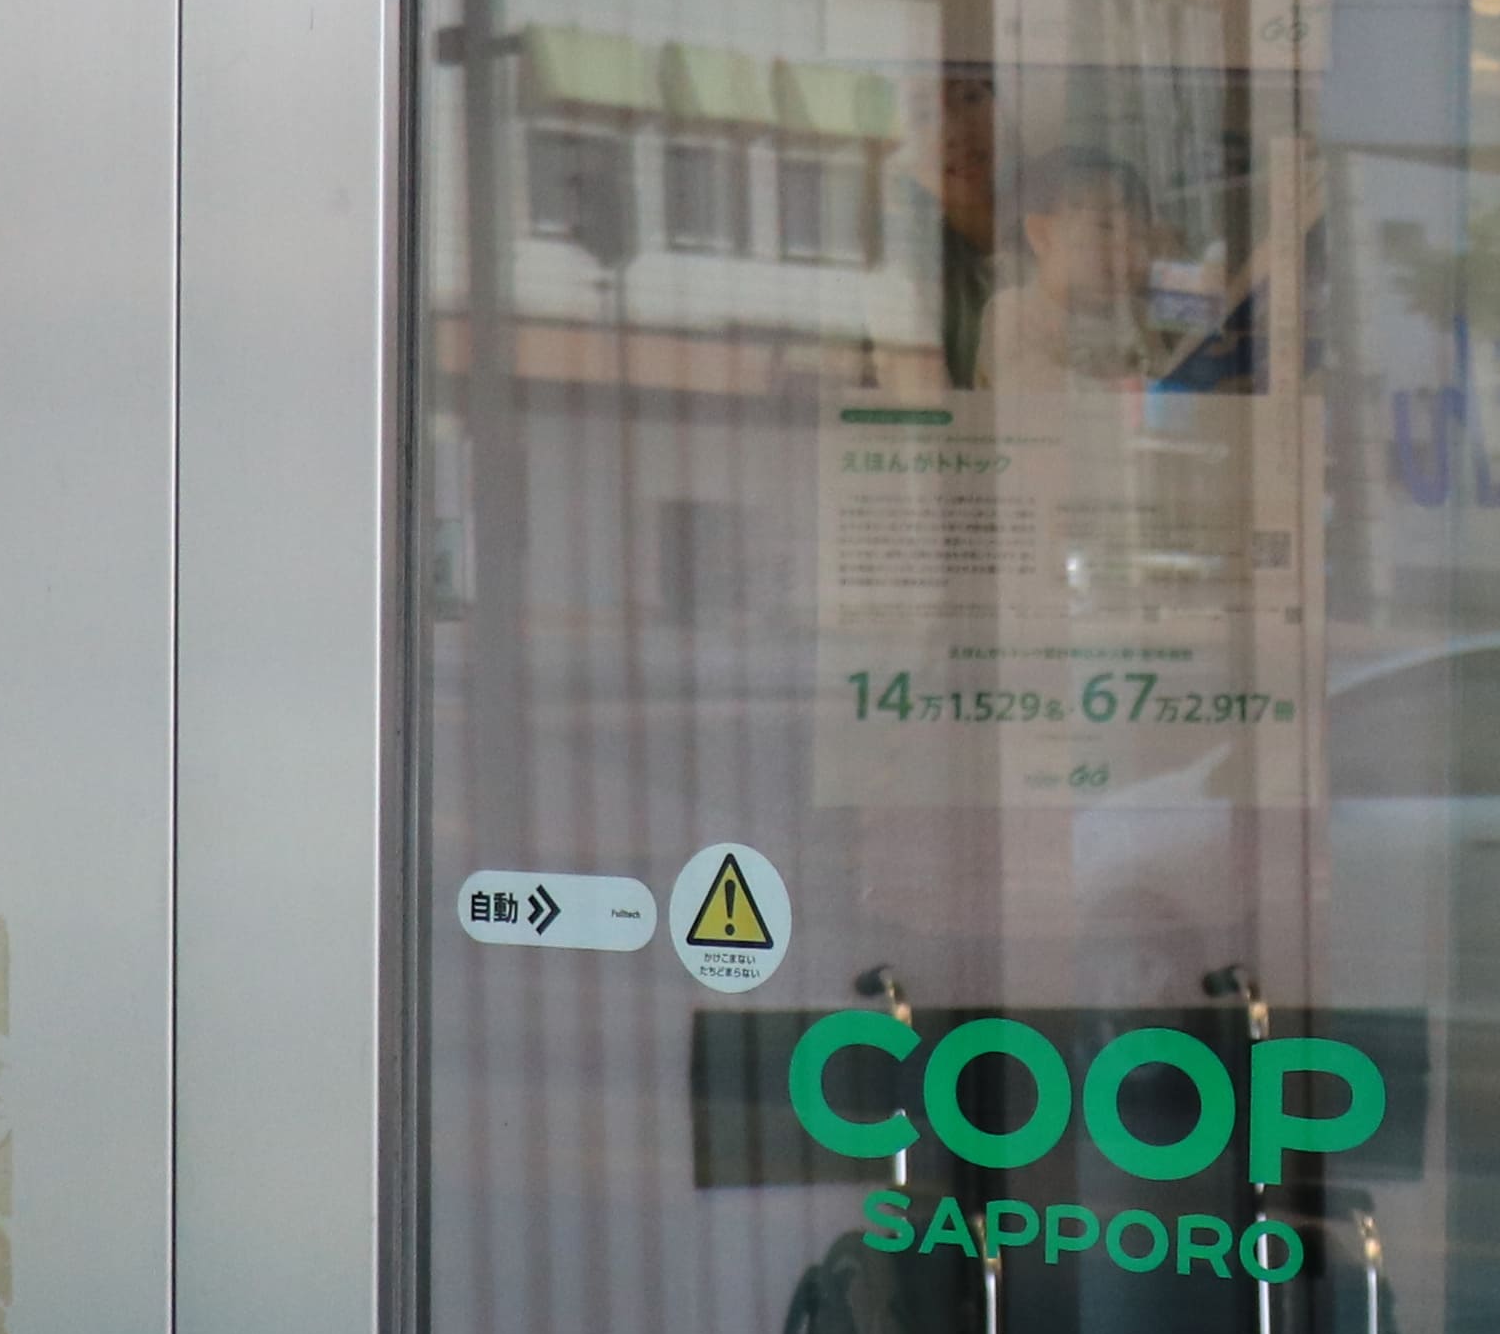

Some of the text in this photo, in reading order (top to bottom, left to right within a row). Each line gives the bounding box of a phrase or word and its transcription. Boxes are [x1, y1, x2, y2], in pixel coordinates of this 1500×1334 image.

[469, 890, 519, 925] 自動
[788, 1008, 1386, 1187] COOP
[861, 1188, 1305, 1285] SAPPORO
